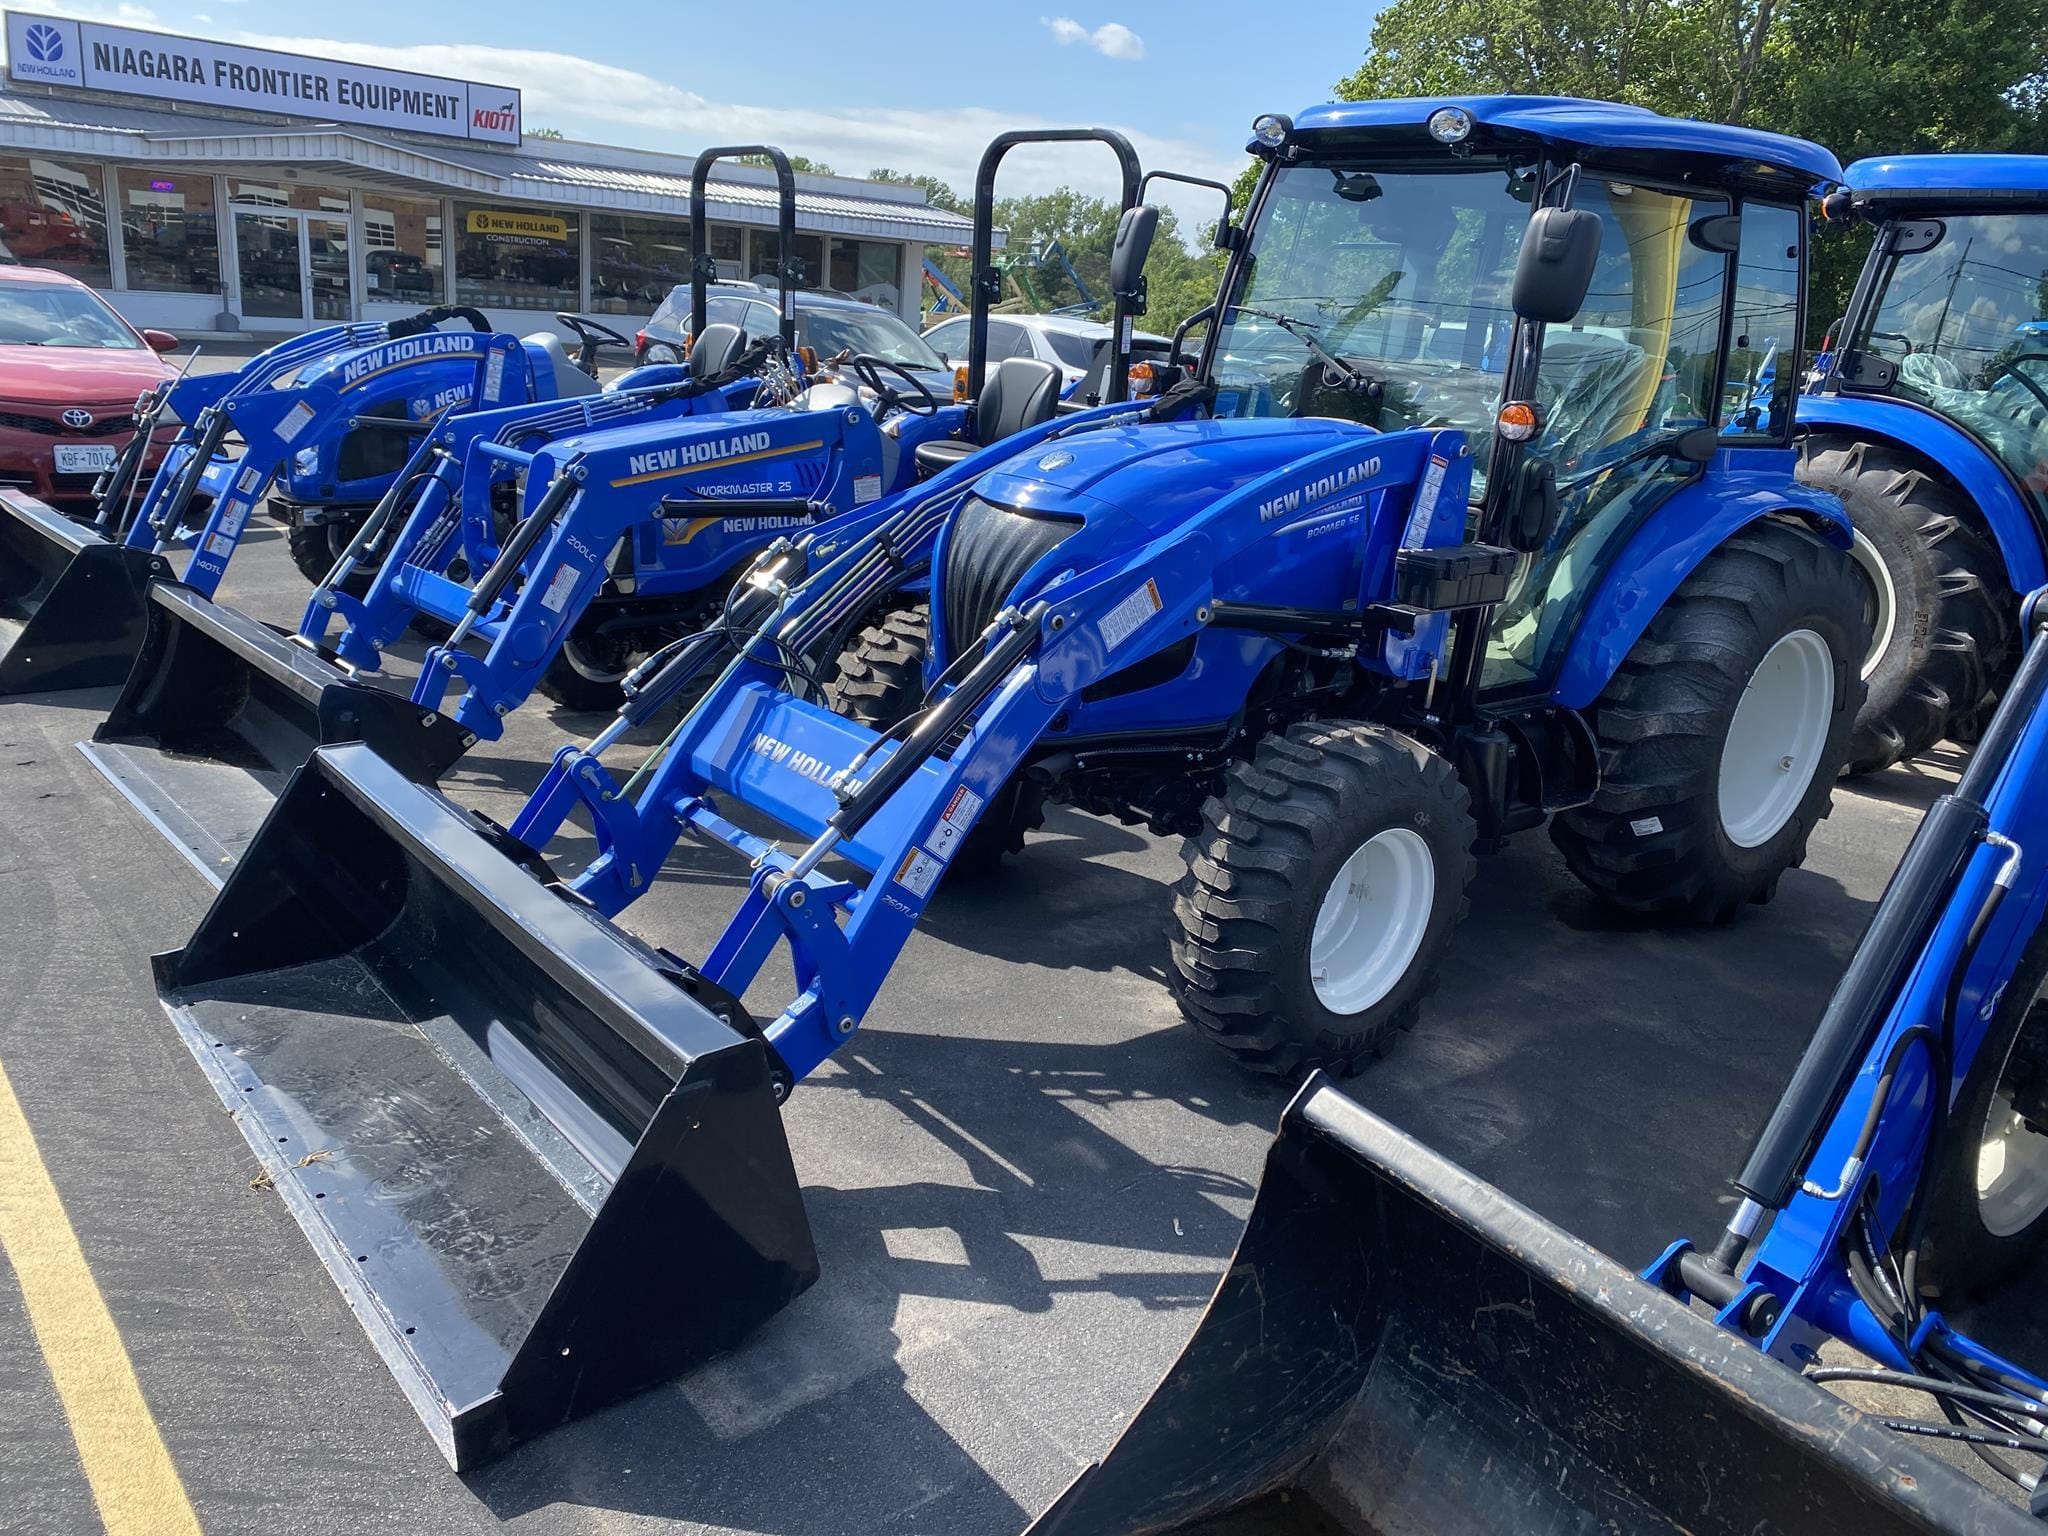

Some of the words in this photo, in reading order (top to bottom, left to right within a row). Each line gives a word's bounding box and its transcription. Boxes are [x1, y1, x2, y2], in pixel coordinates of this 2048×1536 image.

[17, 63, 37, 73] NEW
[37, 66, 76, 78] HOLLAND
[92, 42, 206, 85] NIAGARA
[213, 60, 329, 102] FRONTIER
[337, 78, 460, 120] EQUIPMENT
[473, 109, 516, 132] KIOTI
[491, 219, 514, 229] NEW
[516, 221, 560, 233] HOLLAND
[486, 234, 549, 246] CONSTRUCTION
[344, 349, 384, 383] NEW
[387, 335, 474, 364] HOLLAND
[434, 384, 466, 408] NEW
[629, 449, 677, 475] NEW
[681, 432, 770, 465] HOLLAND
[697, 482, 773, 496] WORKMASTER
[778, 481, 792, 492] 25
[1259, 489, 1300, 523] NEW
[1305, 456, 1382, 504] HOLLAND
[723, 517, 755, 533] NEW
[1306, 518, 1346, 539] BOOMER
[566, 534, 597, 563] 200LC
[196, 559, 221, 575] 140TL
[751, 732, 792, 764] NEW
[785, 750, 863, 798] HOLLAN
